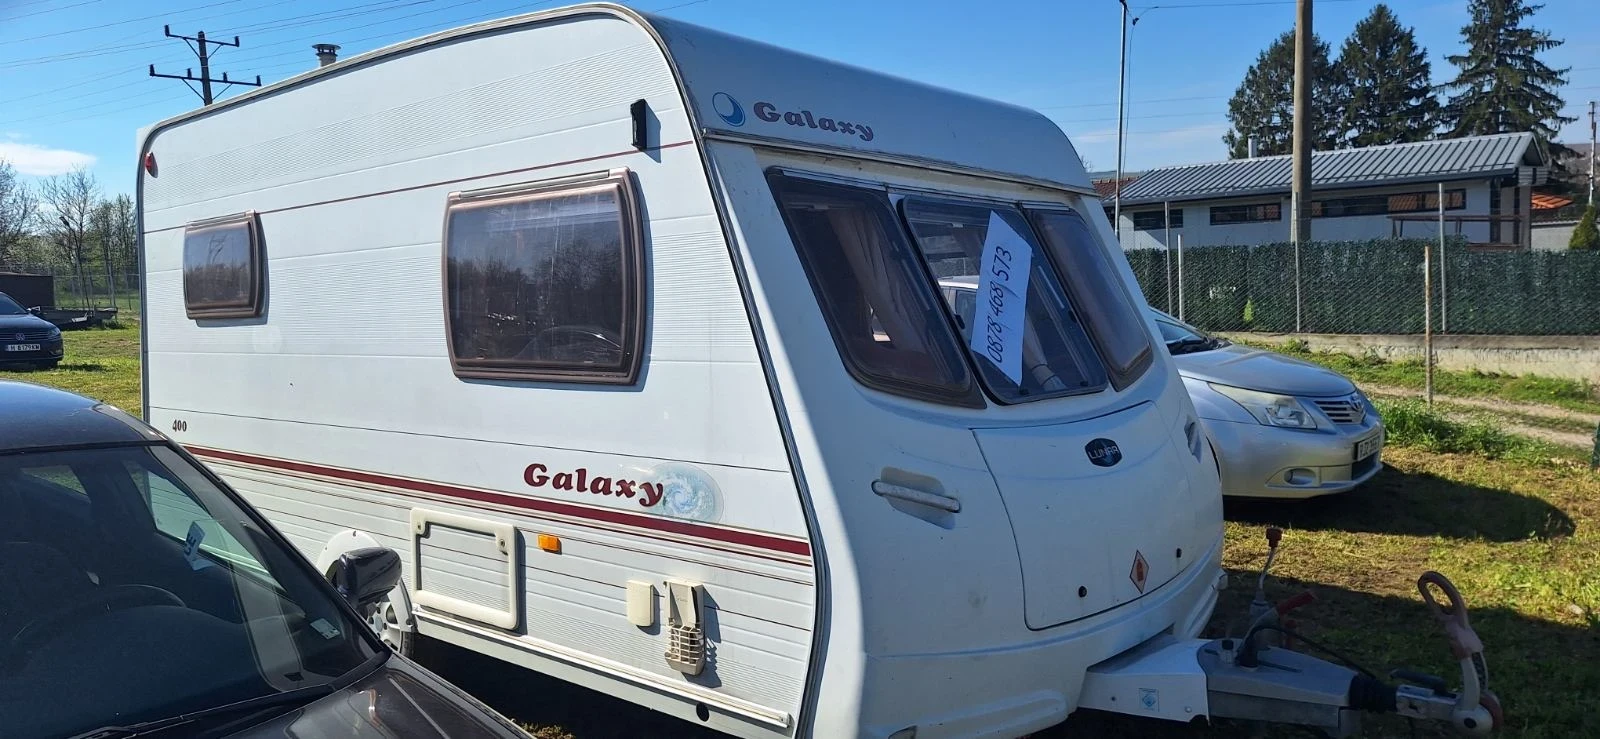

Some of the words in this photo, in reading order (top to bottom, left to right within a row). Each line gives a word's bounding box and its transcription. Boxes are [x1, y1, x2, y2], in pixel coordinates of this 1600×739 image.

[753, 101, 874, 142] Galaxy
[991, 246, 1012, 281] 573
[988, 280, 1004, 316] 468
[986, 315, 1004, 363] 0878
[172, 419, 187, 432] 400
[1088, 445, 1119, 459] LUNAR
[523, 463, 664, 507] Galaxy
